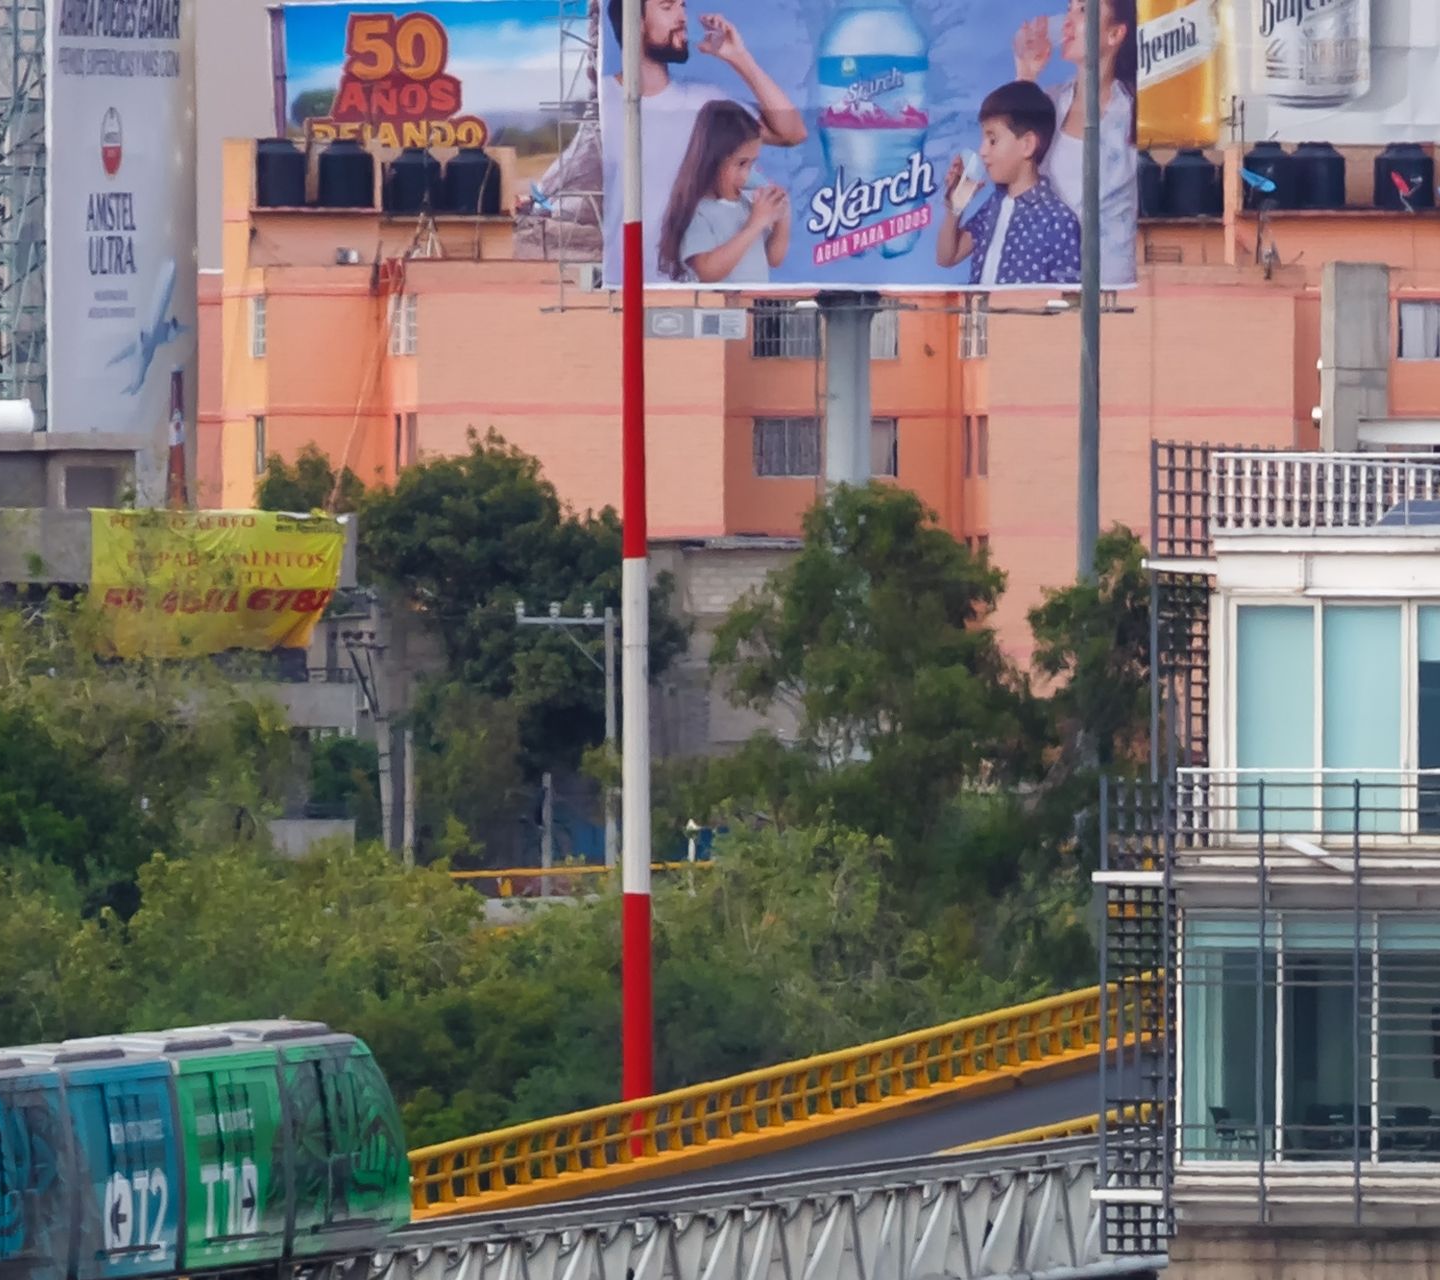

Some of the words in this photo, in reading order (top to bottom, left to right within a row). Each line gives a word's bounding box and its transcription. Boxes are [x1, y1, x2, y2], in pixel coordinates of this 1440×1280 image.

[350, 17, 444, 81] 50
[1137, 16, 1198, 75] hemia
[337, 80, 457, 116] AÑOS
[86, 193, 136, 231] AMSTEL
[808, 150, 936, 238] Skarch
[88, 236, 137, 275] ULTRA
[815, 240, 849, 264] AGUA
[852, 227, 885, 250] PARA
[888, 206, 930, 237] TODOS
